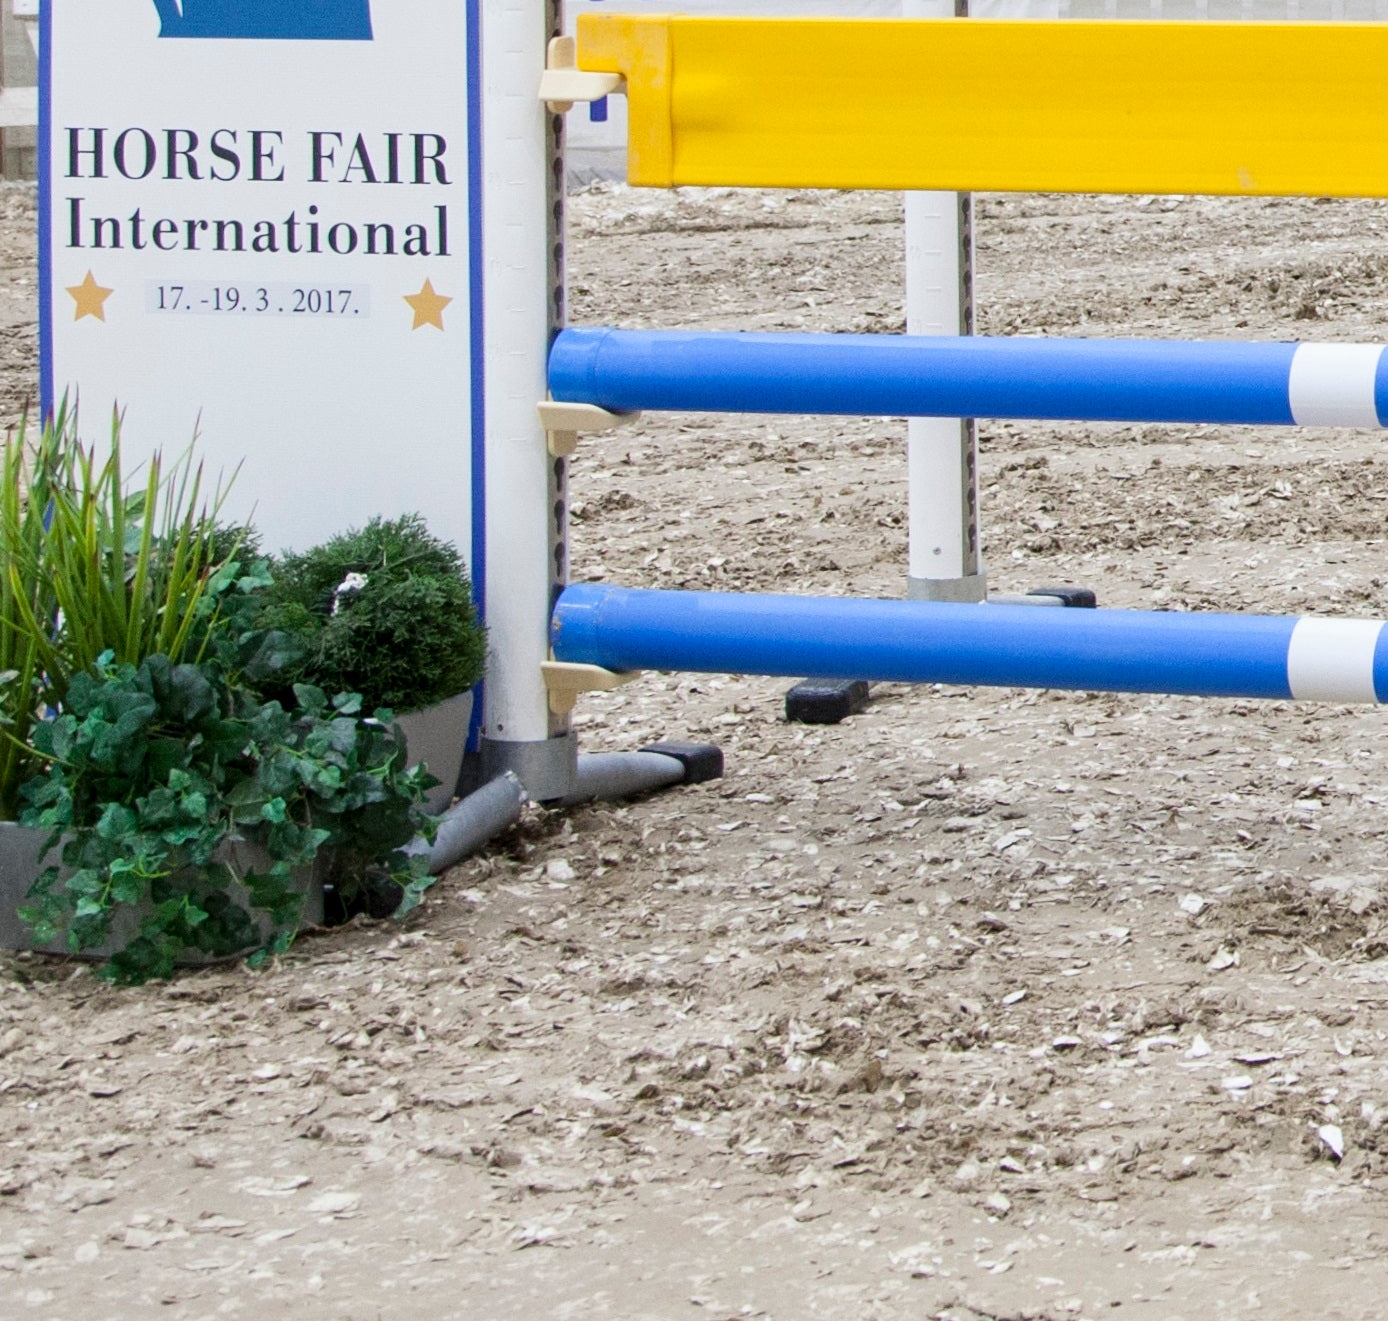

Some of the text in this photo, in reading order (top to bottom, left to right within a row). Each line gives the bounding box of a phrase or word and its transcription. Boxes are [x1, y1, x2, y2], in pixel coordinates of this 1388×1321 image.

[65, 128, 451, 184] HORSE FAIR
[66, 198, 450, 256] International
